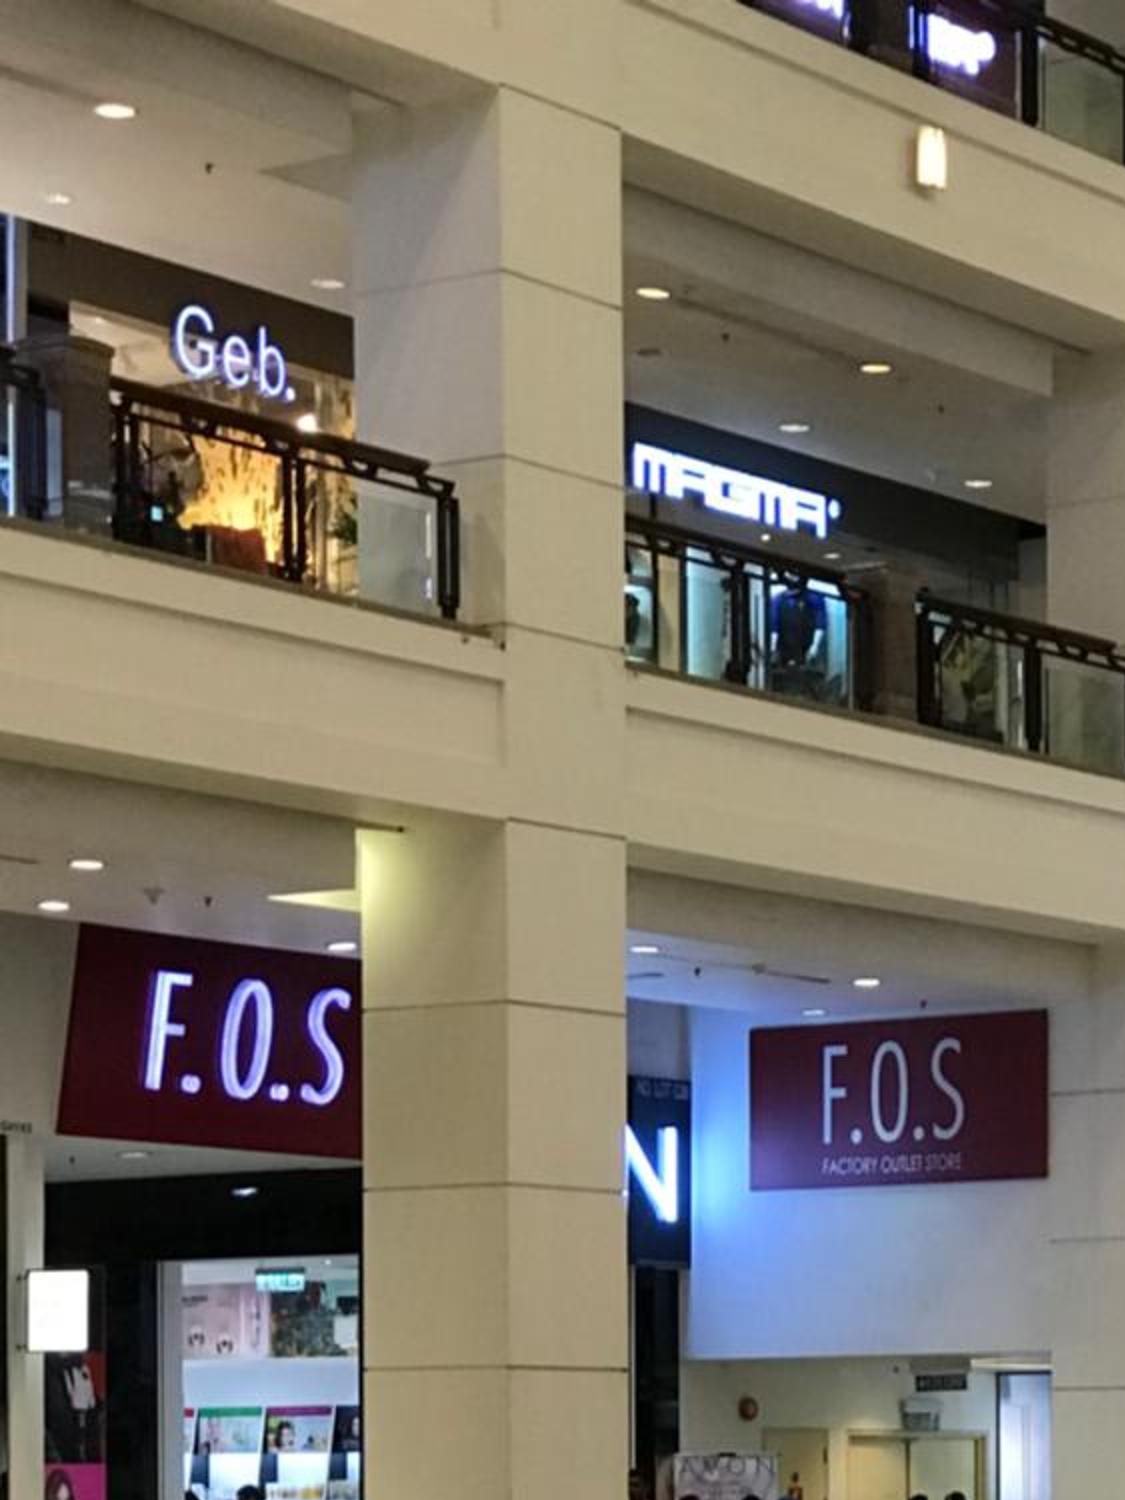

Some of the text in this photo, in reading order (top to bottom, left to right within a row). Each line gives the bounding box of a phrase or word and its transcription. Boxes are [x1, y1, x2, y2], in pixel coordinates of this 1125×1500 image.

[175, 305, 296, 401] Geb.
[823, 1037, 965, 1146] F.O.S
[821, 1152, 961, 1176] FACTORY OUTLET STORE
